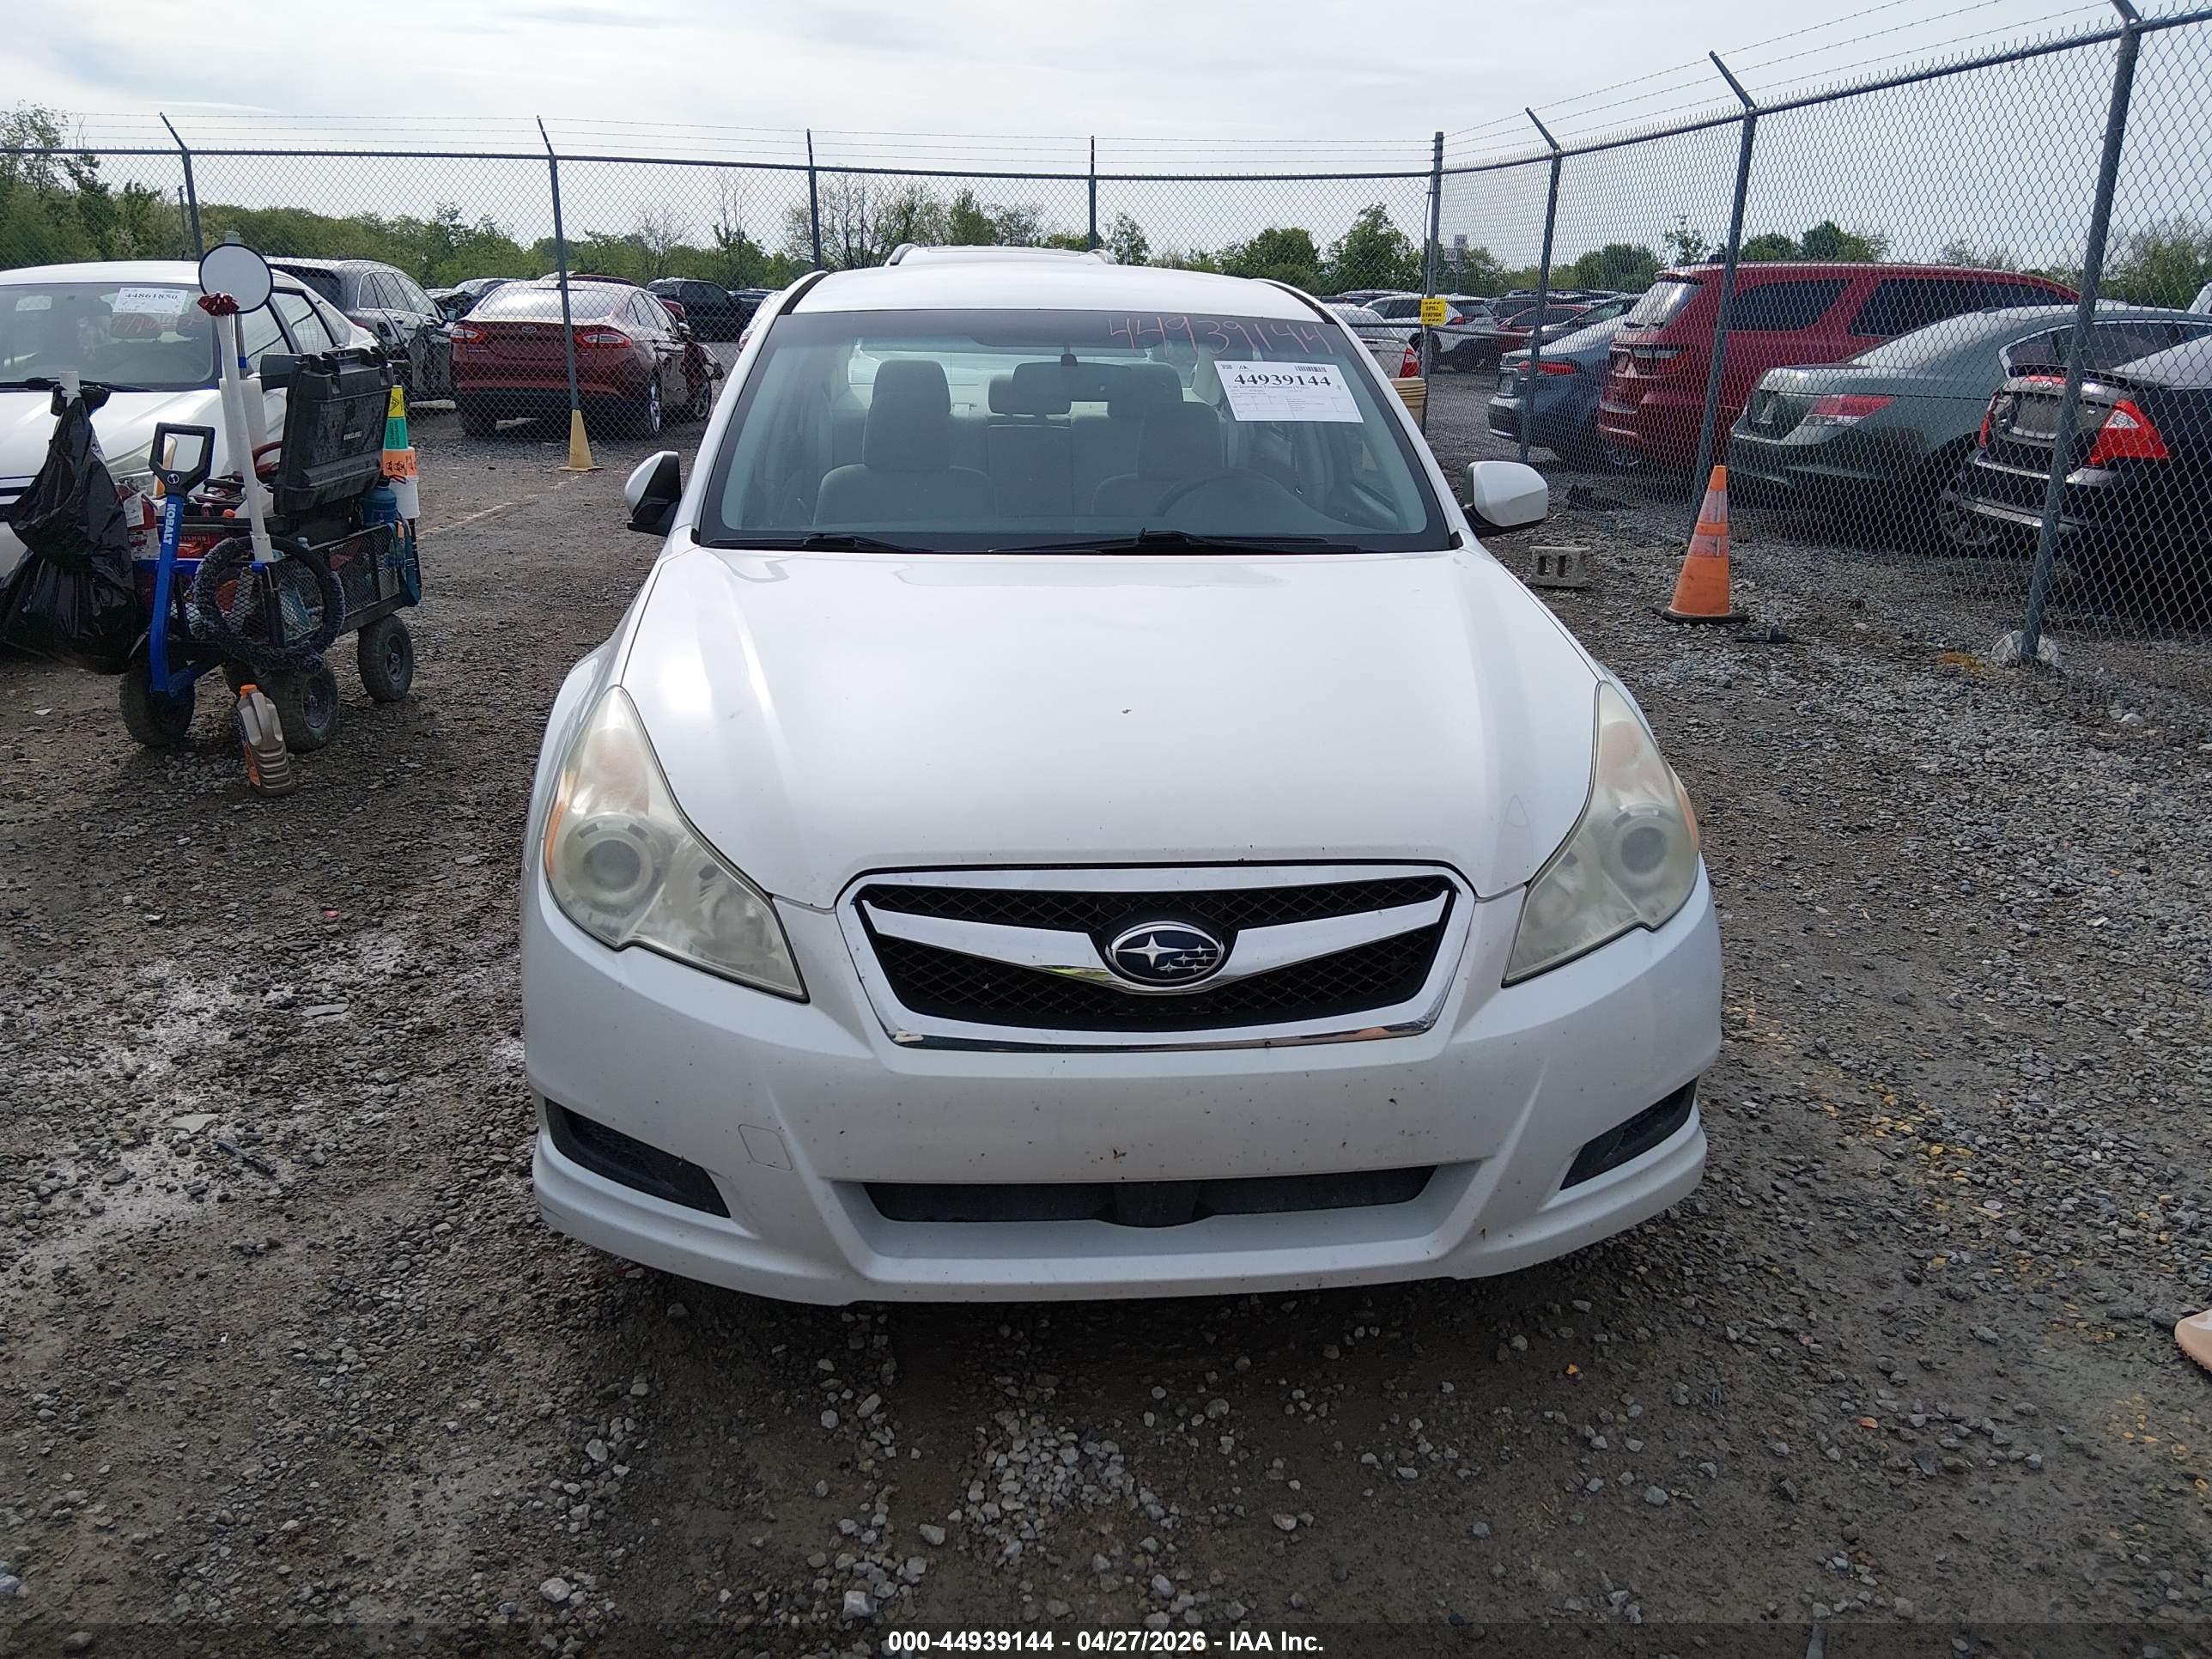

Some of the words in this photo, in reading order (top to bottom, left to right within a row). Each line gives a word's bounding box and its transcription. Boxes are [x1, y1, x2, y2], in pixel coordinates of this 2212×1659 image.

[1109, 315, 1334, 358] 44939144
[1234, 374, 1331, 386] 44939144
[163, 503, 177, 544] KOBALT
